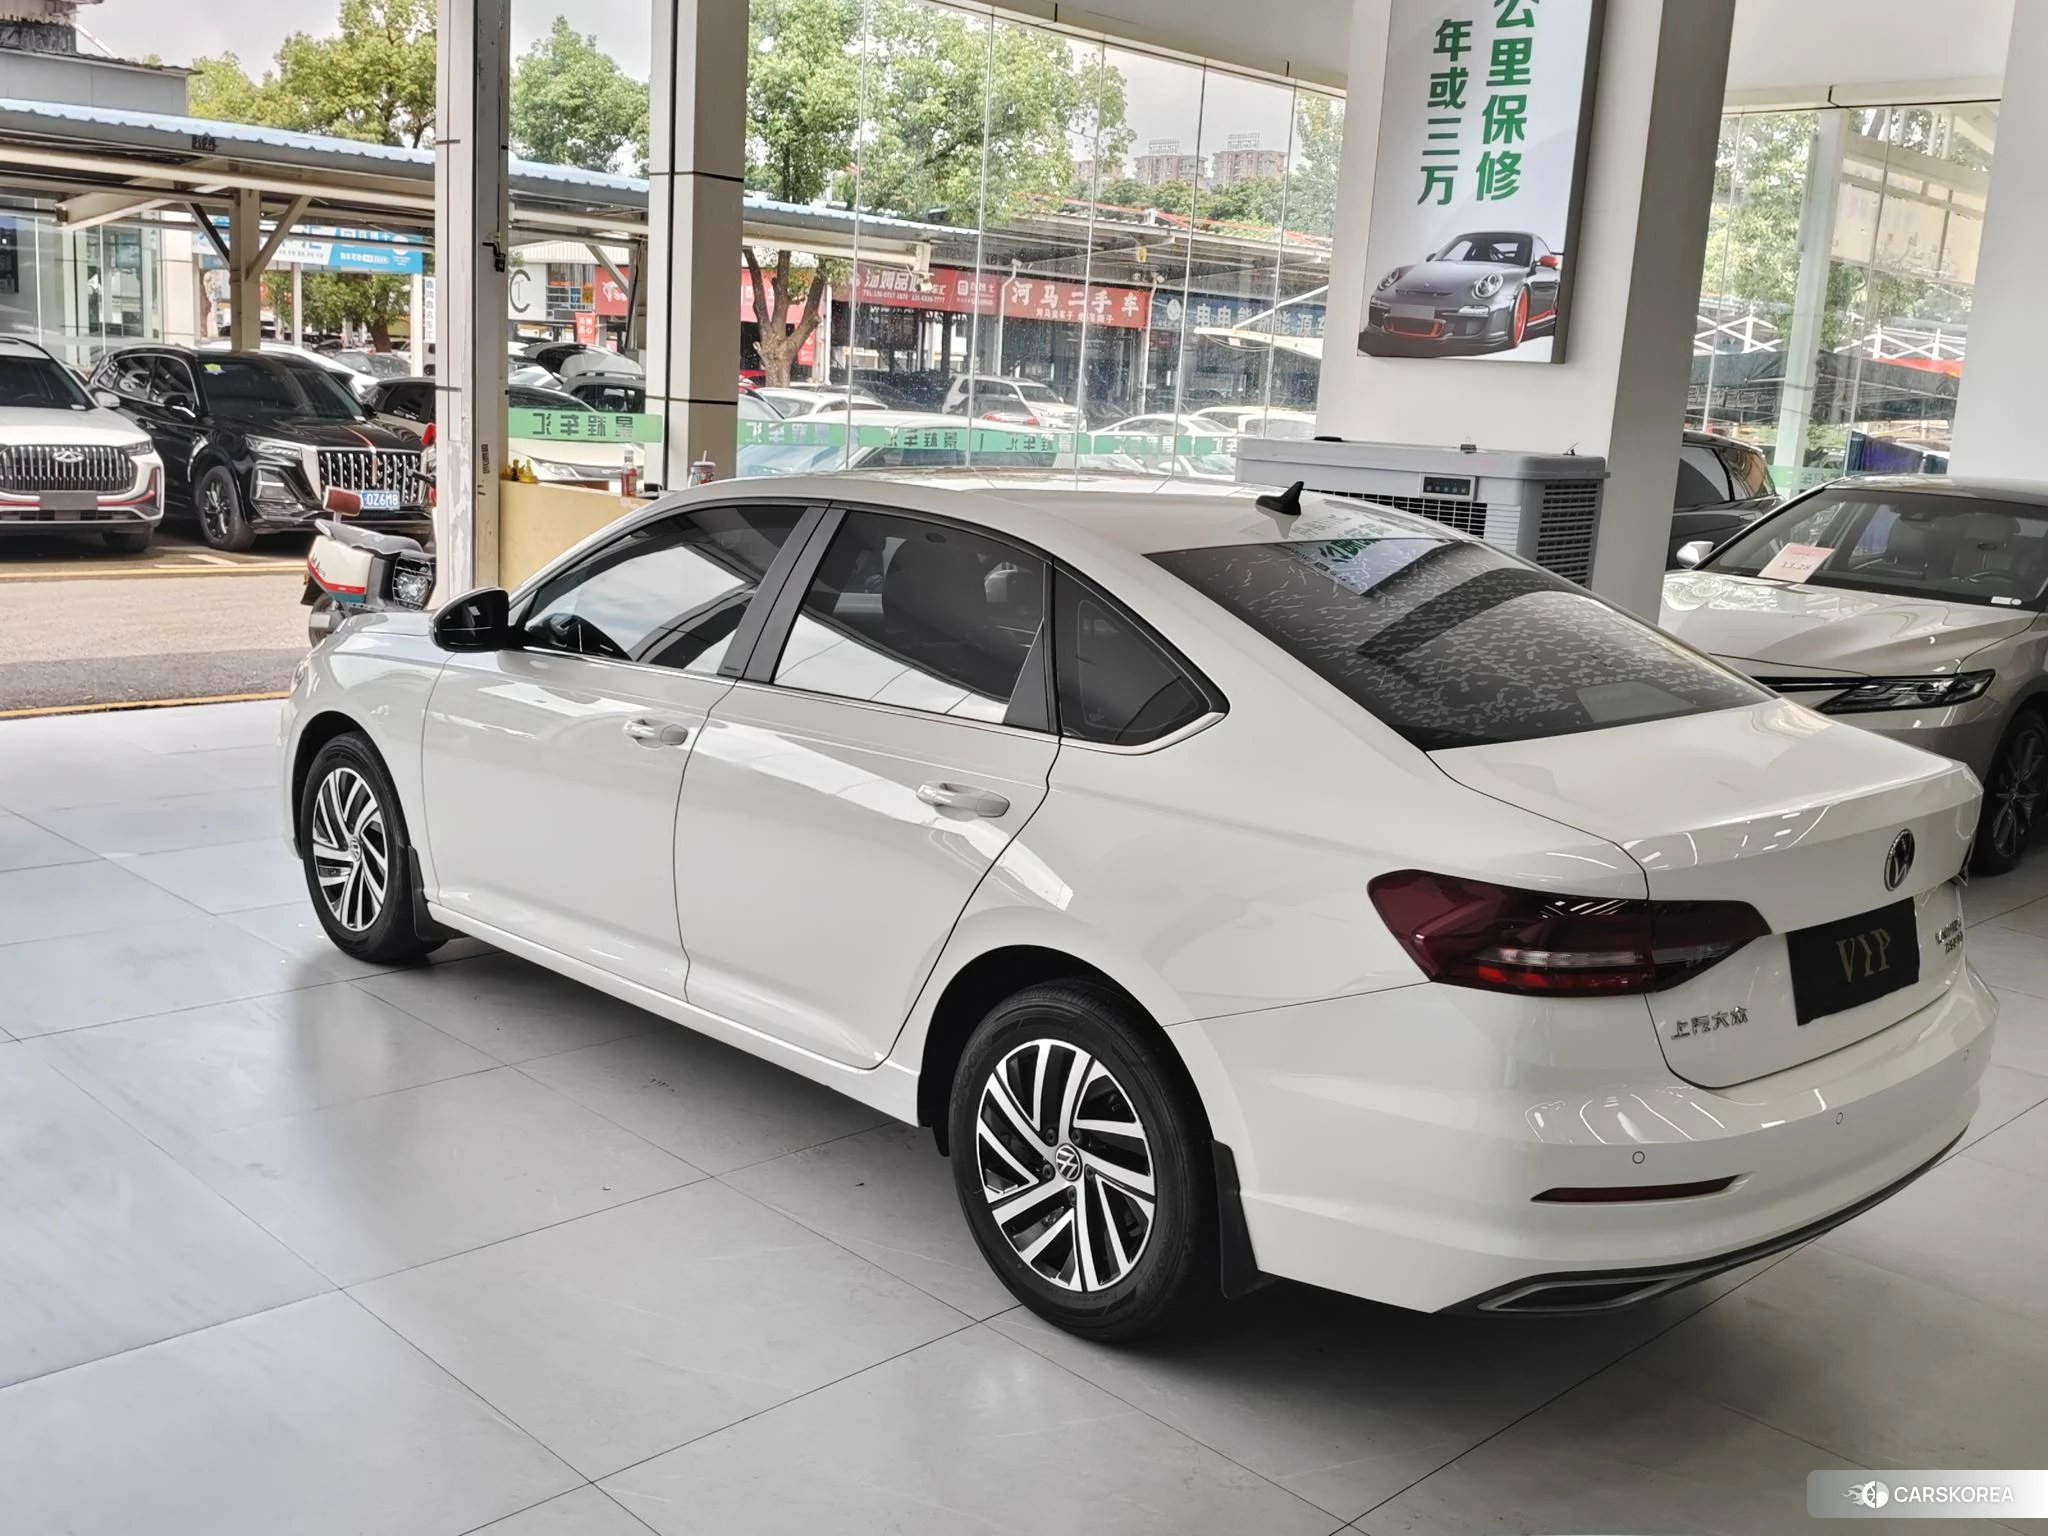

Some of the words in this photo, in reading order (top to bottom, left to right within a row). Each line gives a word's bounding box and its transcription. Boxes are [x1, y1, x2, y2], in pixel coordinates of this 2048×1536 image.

[1417, 19, 1473, 206] 年或三万
[1475, 0, 1540, 202] 公里保修
[1011, 280, 1140, 317] 河马二手车
[1836, 928, 1891, 982] VIP
